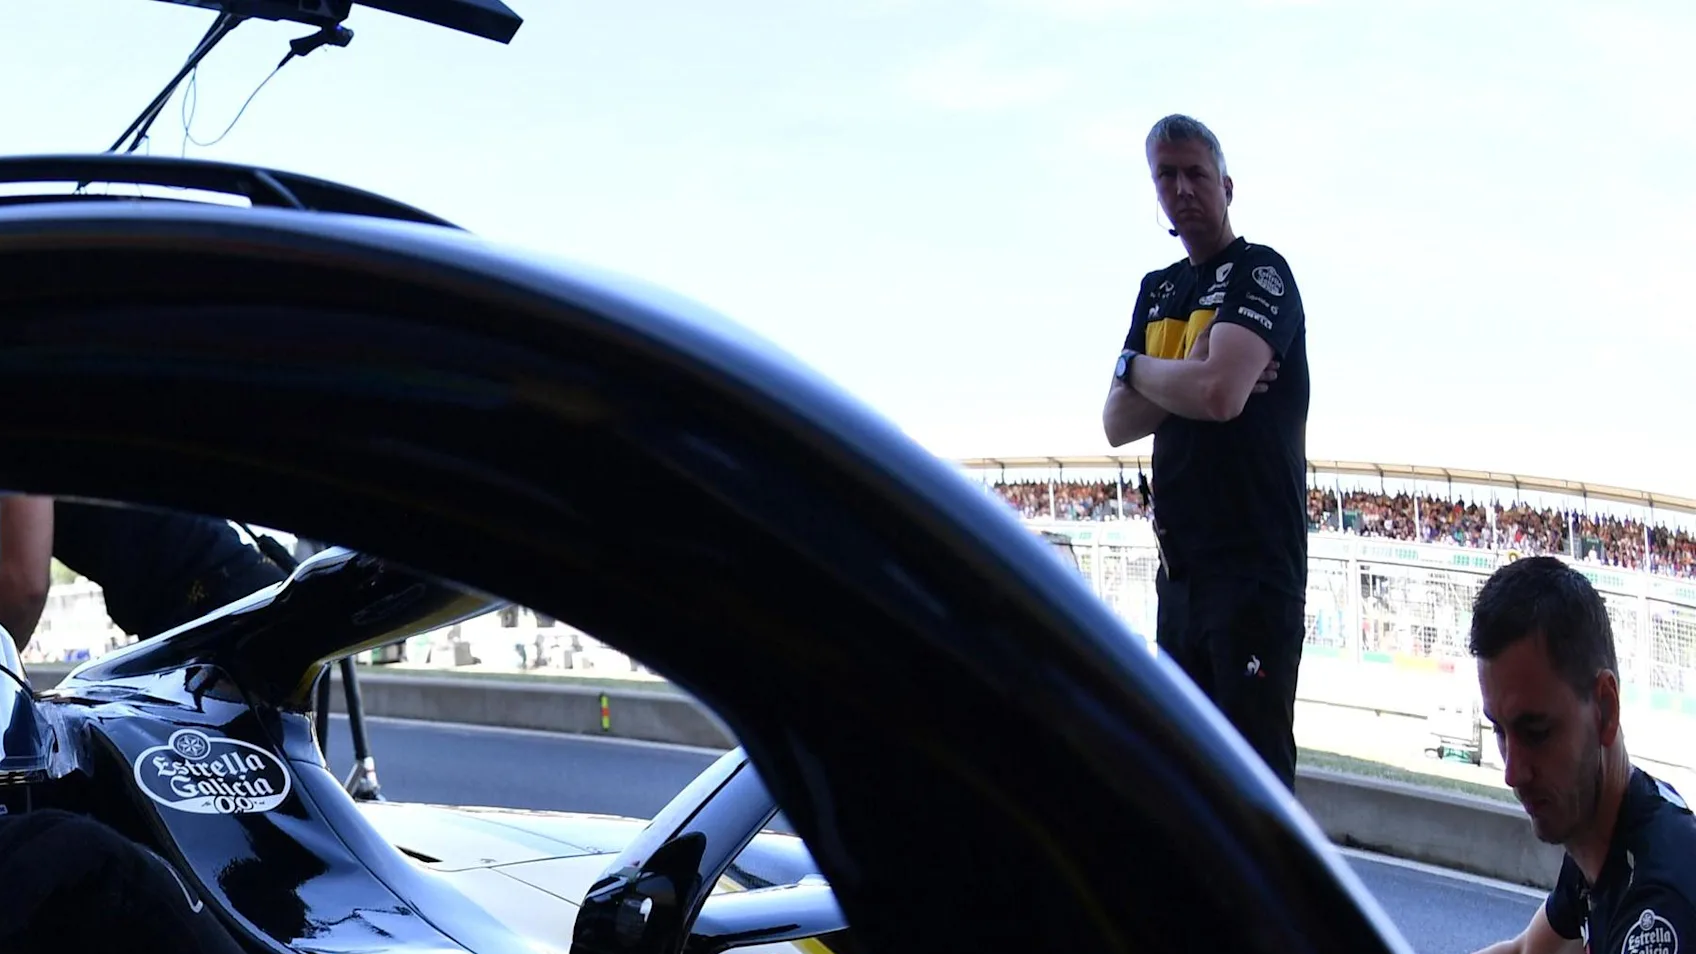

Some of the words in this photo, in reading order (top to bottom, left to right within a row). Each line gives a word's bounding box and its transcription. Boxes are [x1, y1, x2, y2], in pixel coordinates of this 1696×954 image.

[152, 751, 266, 777] Estrella
[170, 774, 274, 798] Galicia
[1628, 927, 1671, 951] Estrella
